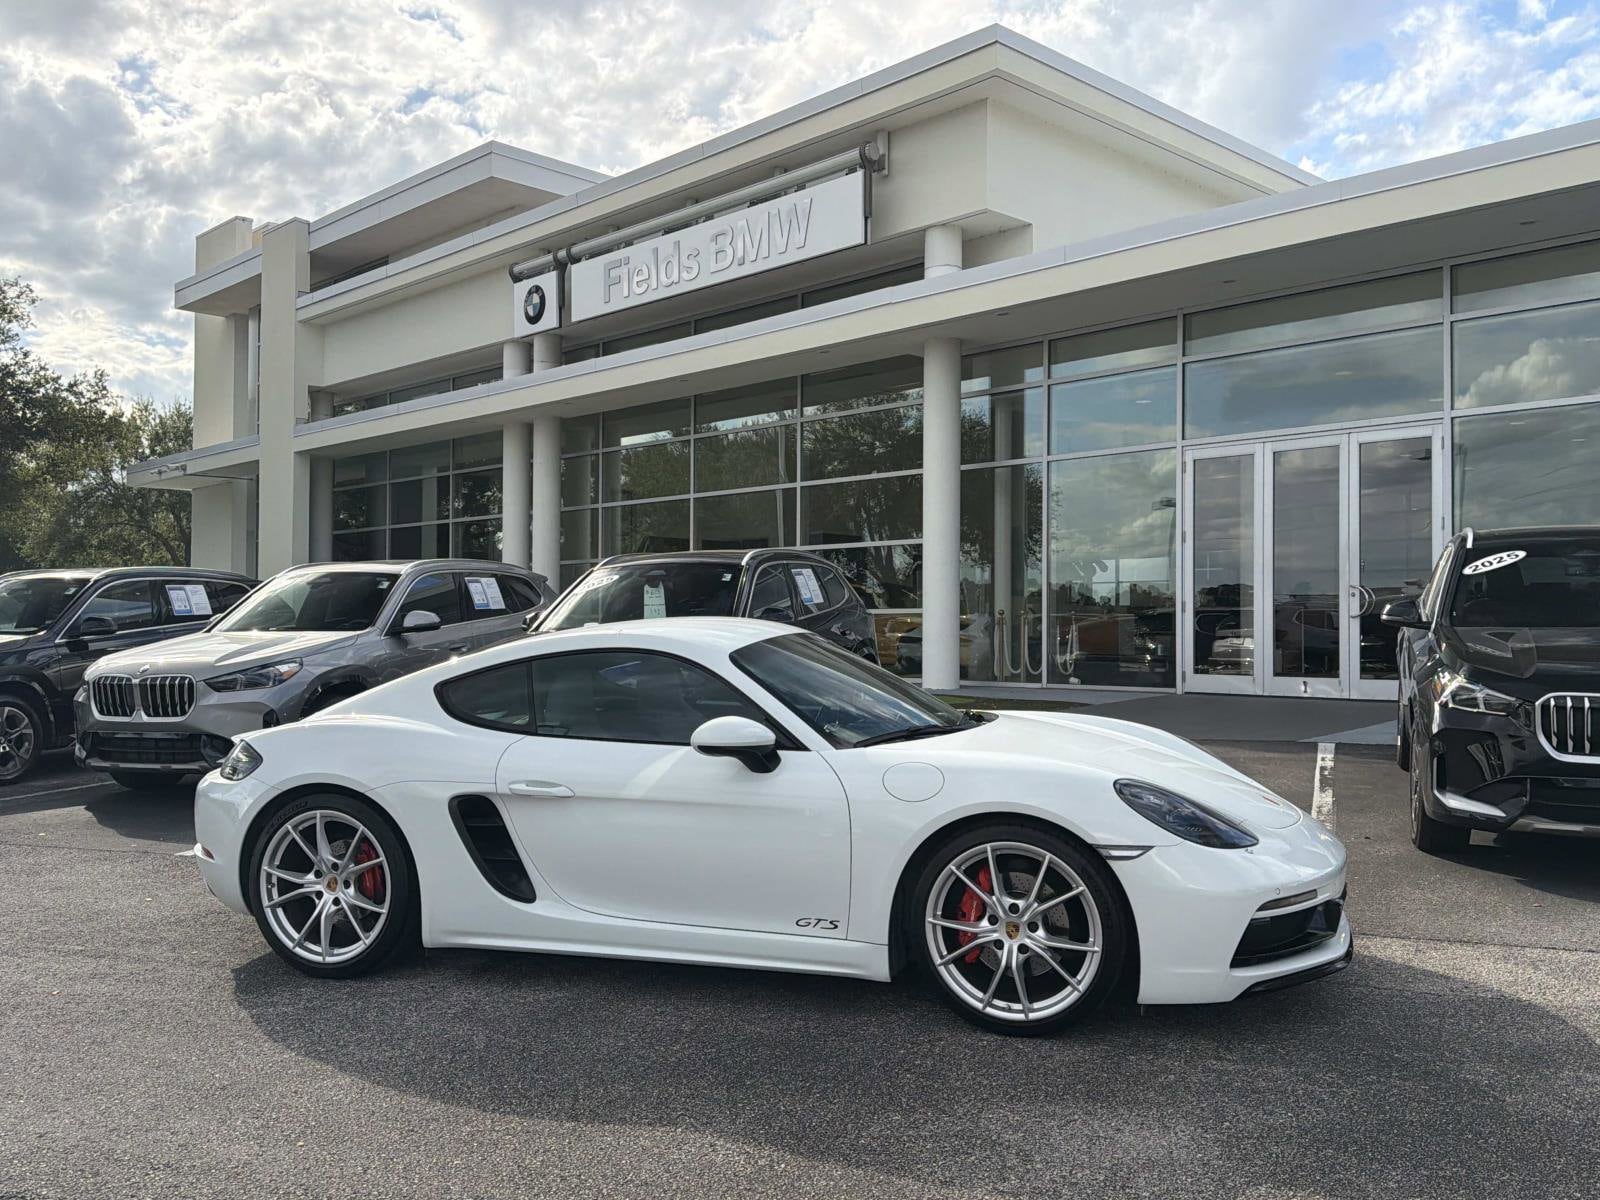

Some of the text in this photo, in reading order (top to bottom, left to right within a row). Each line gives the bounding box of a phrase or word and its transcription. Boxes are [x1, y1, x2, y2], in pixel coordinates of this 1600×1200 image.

[604, 197, 814, 304] Fields BMW
[1467, 551, 1520, 573] 2025
[795, 917, 841, 930] GTS
